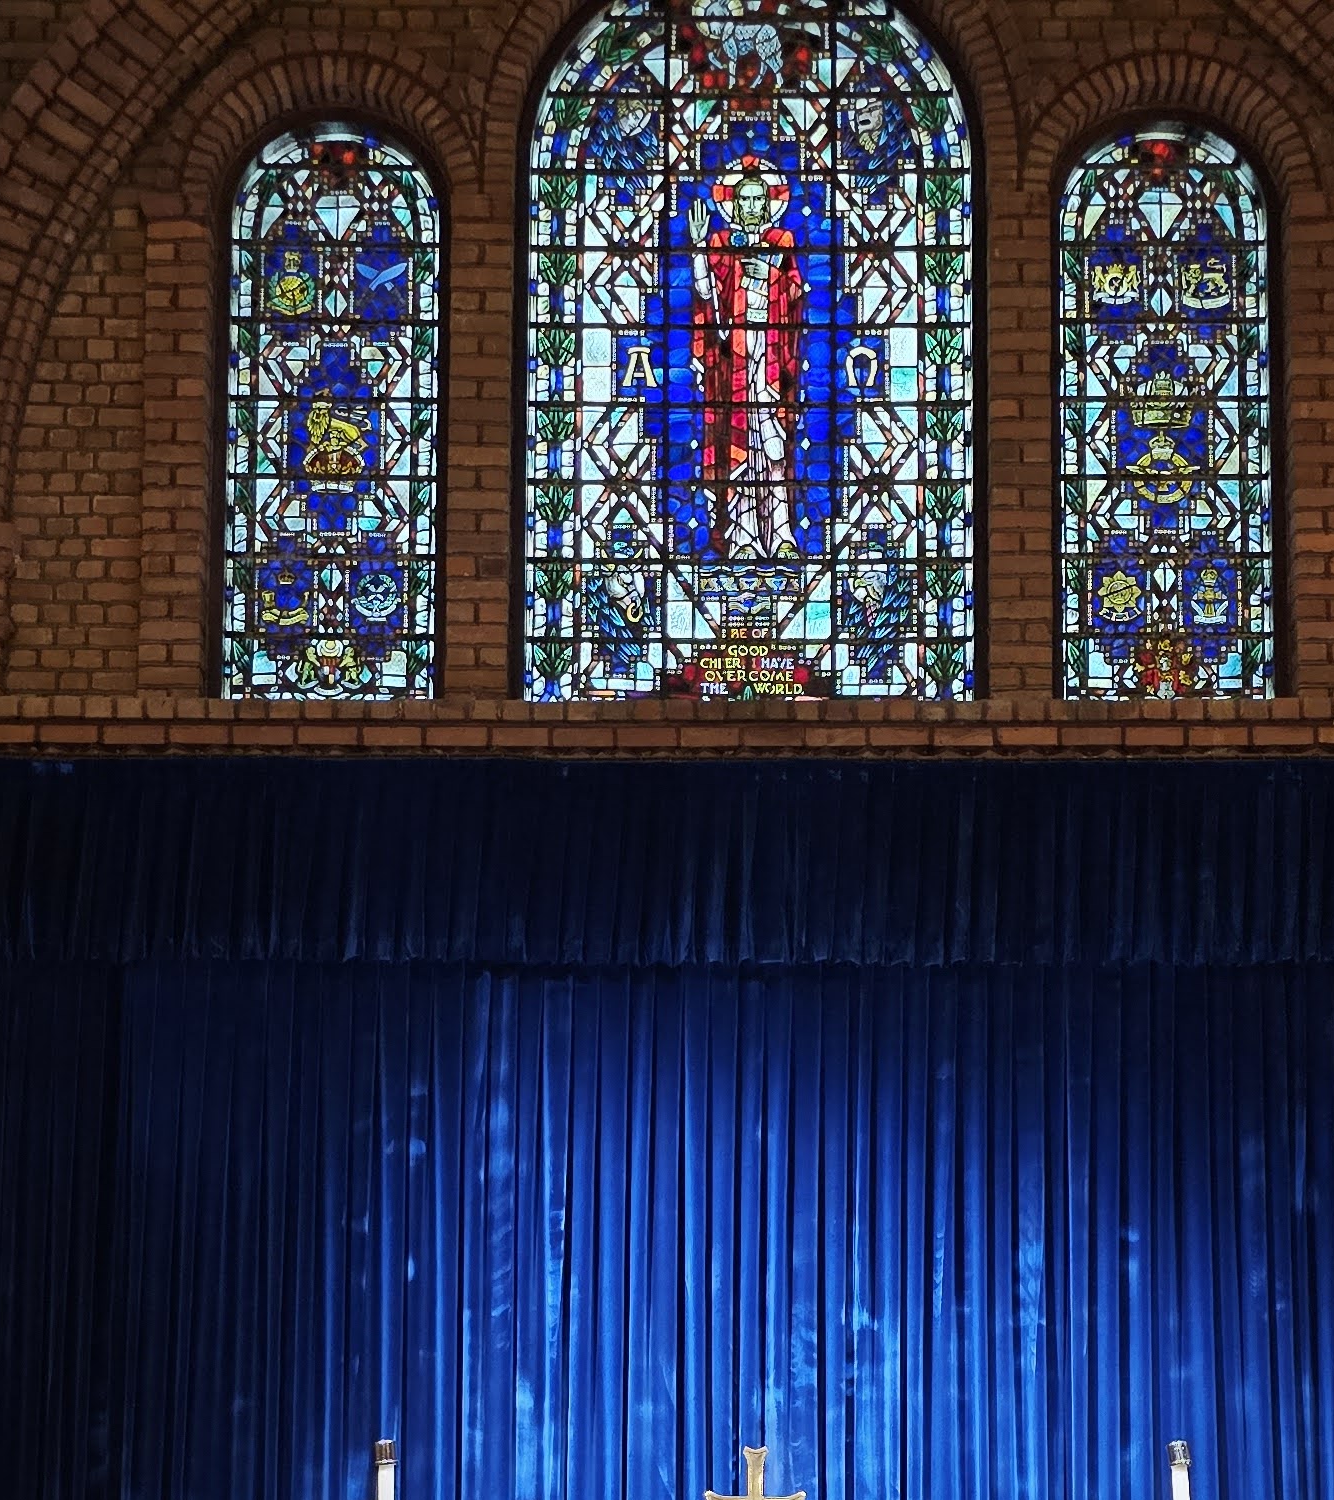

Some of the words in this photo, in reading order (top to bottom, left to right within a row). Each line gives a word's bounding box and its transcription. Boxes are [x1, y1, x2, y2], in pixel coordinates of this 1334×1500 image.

[751, 627, 769, 639] OF
[727, 644, 769, 657] GOOD
[751, 657, 757, 669] I
[760, 656, 795, 670] HAVE
[700, 682, 729, 695] THE
